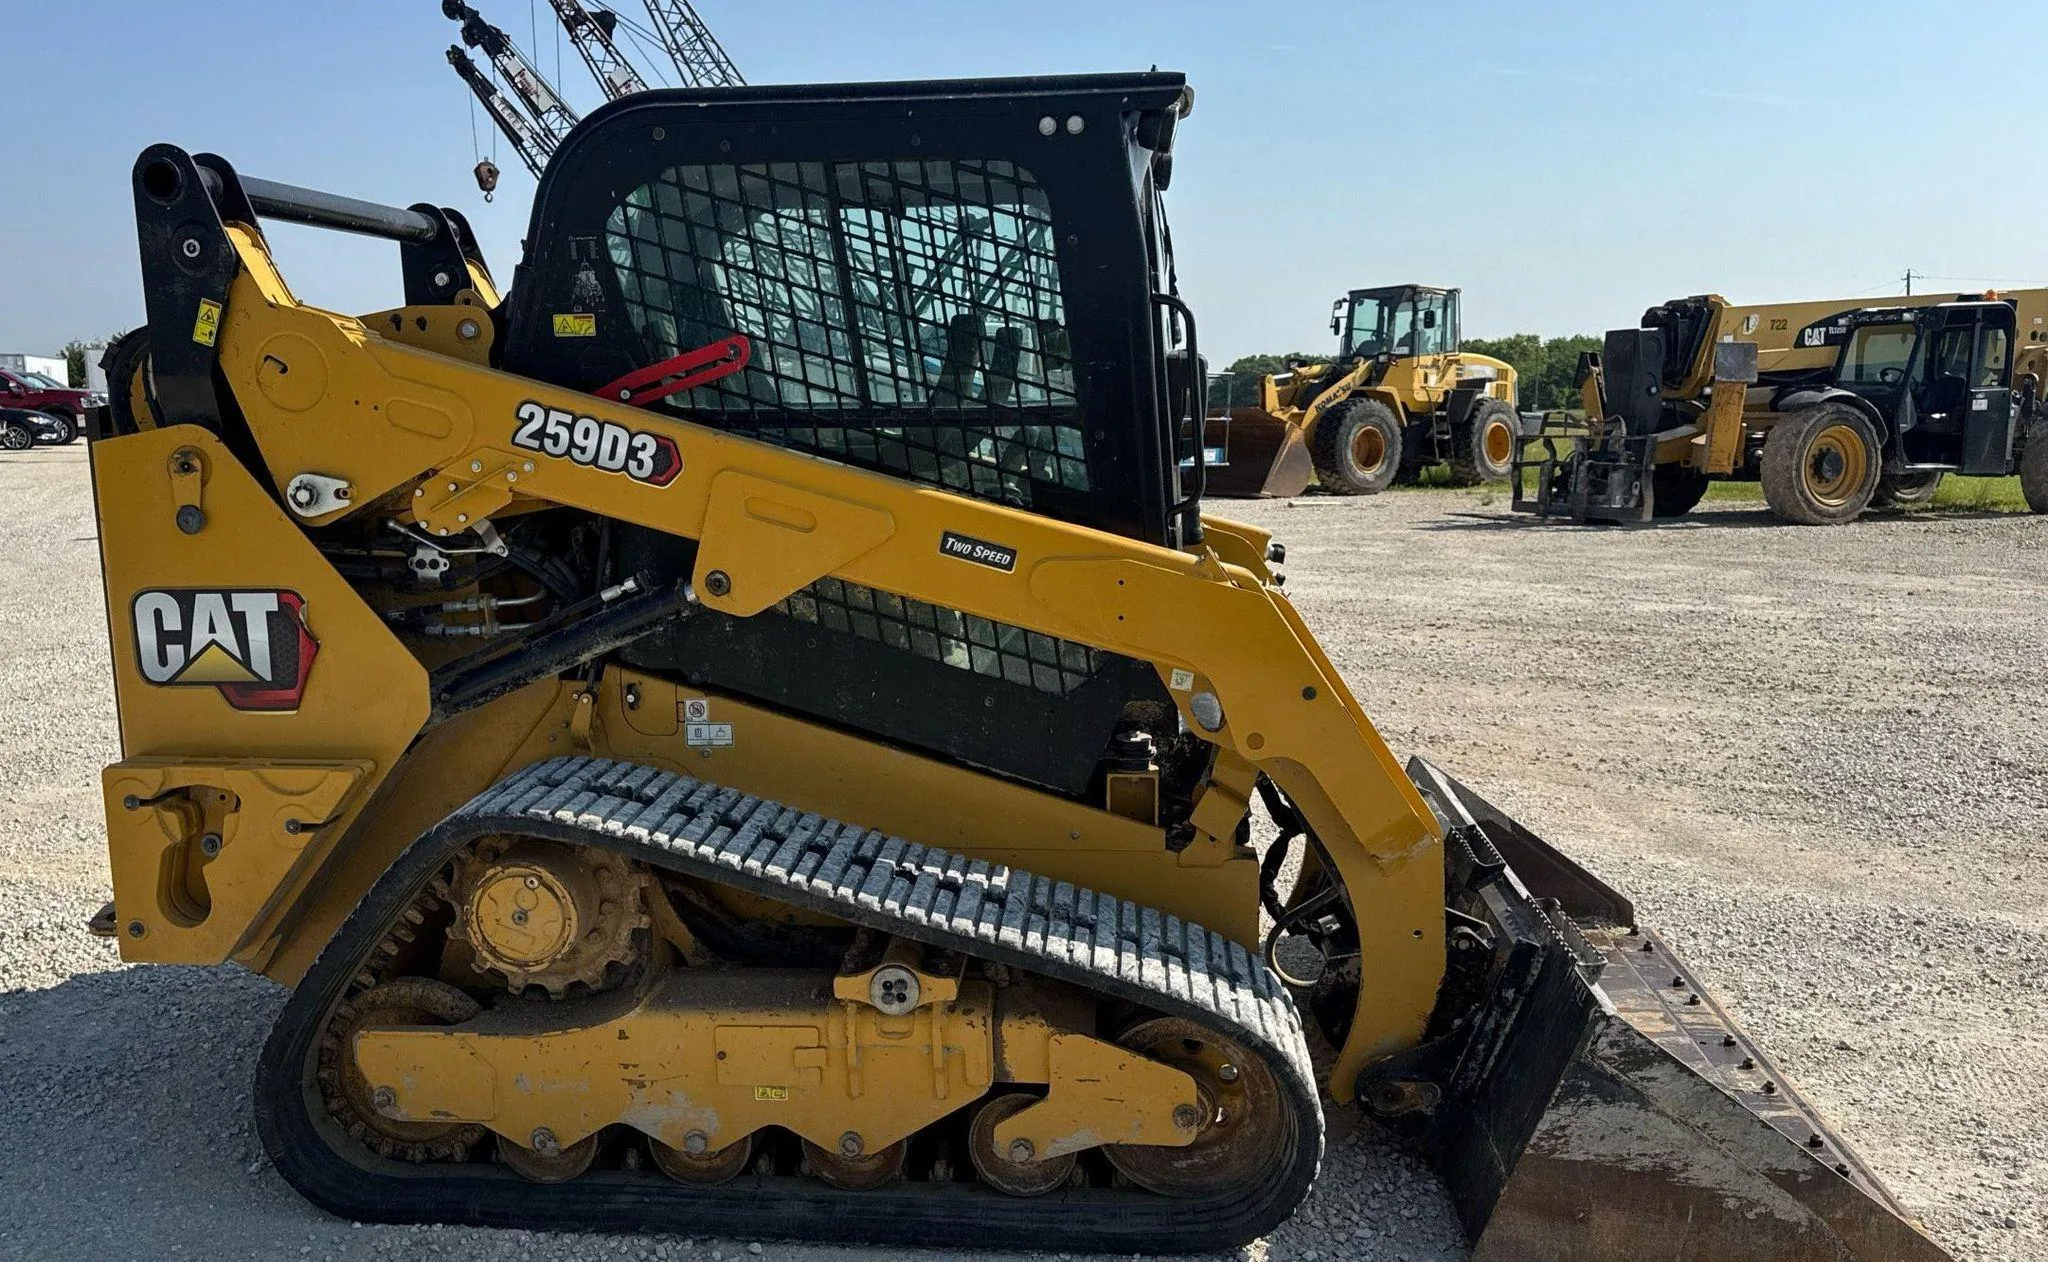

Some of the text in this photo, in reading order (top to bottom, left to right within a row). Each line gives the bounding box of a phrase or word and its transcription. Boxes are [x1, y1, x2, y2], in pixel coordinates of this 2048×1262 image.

[1770, 319, 1787, 330] 722
[1804, 327, 1827, 346] CAT
[514, 403, 657, 479] 259D3
[945, 537, 1011, 565] TWO SPEED
[134, 591, 279, 682] CAT
